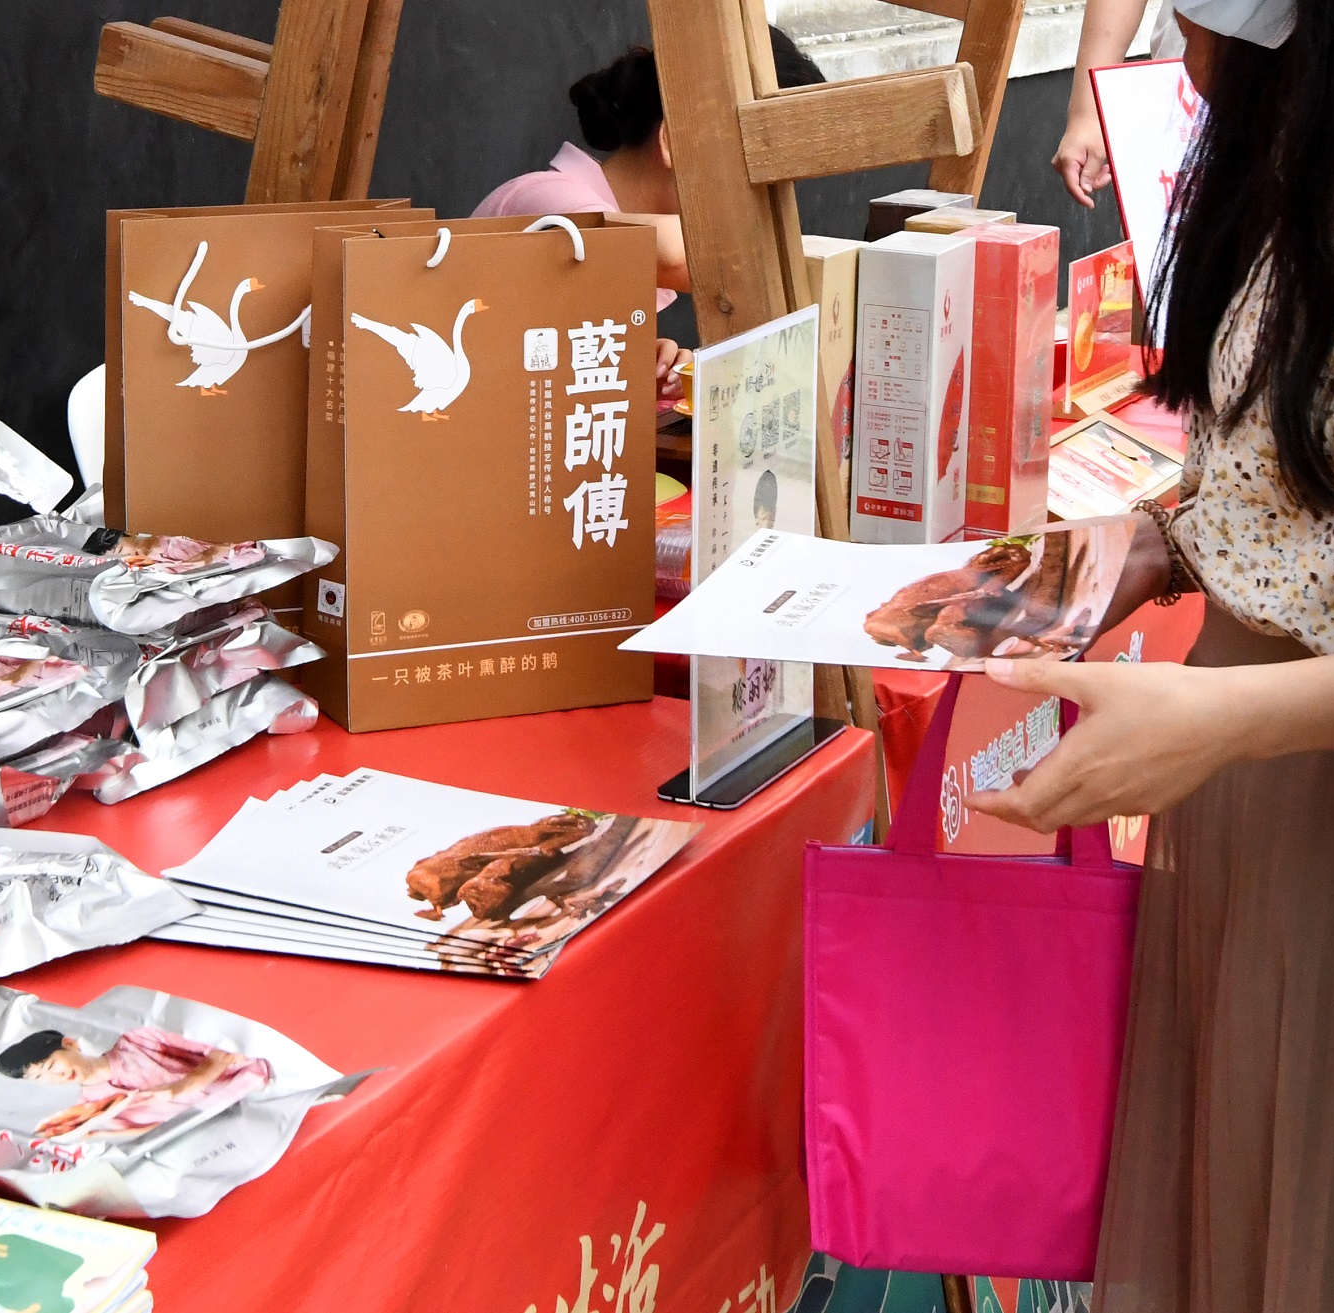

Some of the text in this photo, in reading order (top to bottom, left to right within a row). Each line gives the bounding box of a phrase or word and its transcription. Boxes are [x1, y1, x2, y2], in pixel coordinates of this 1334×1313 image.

[564, 318, 630, 550] 藍師傅
[371, 651, 558, 686] 一只被茶叶熏醉的鹅
